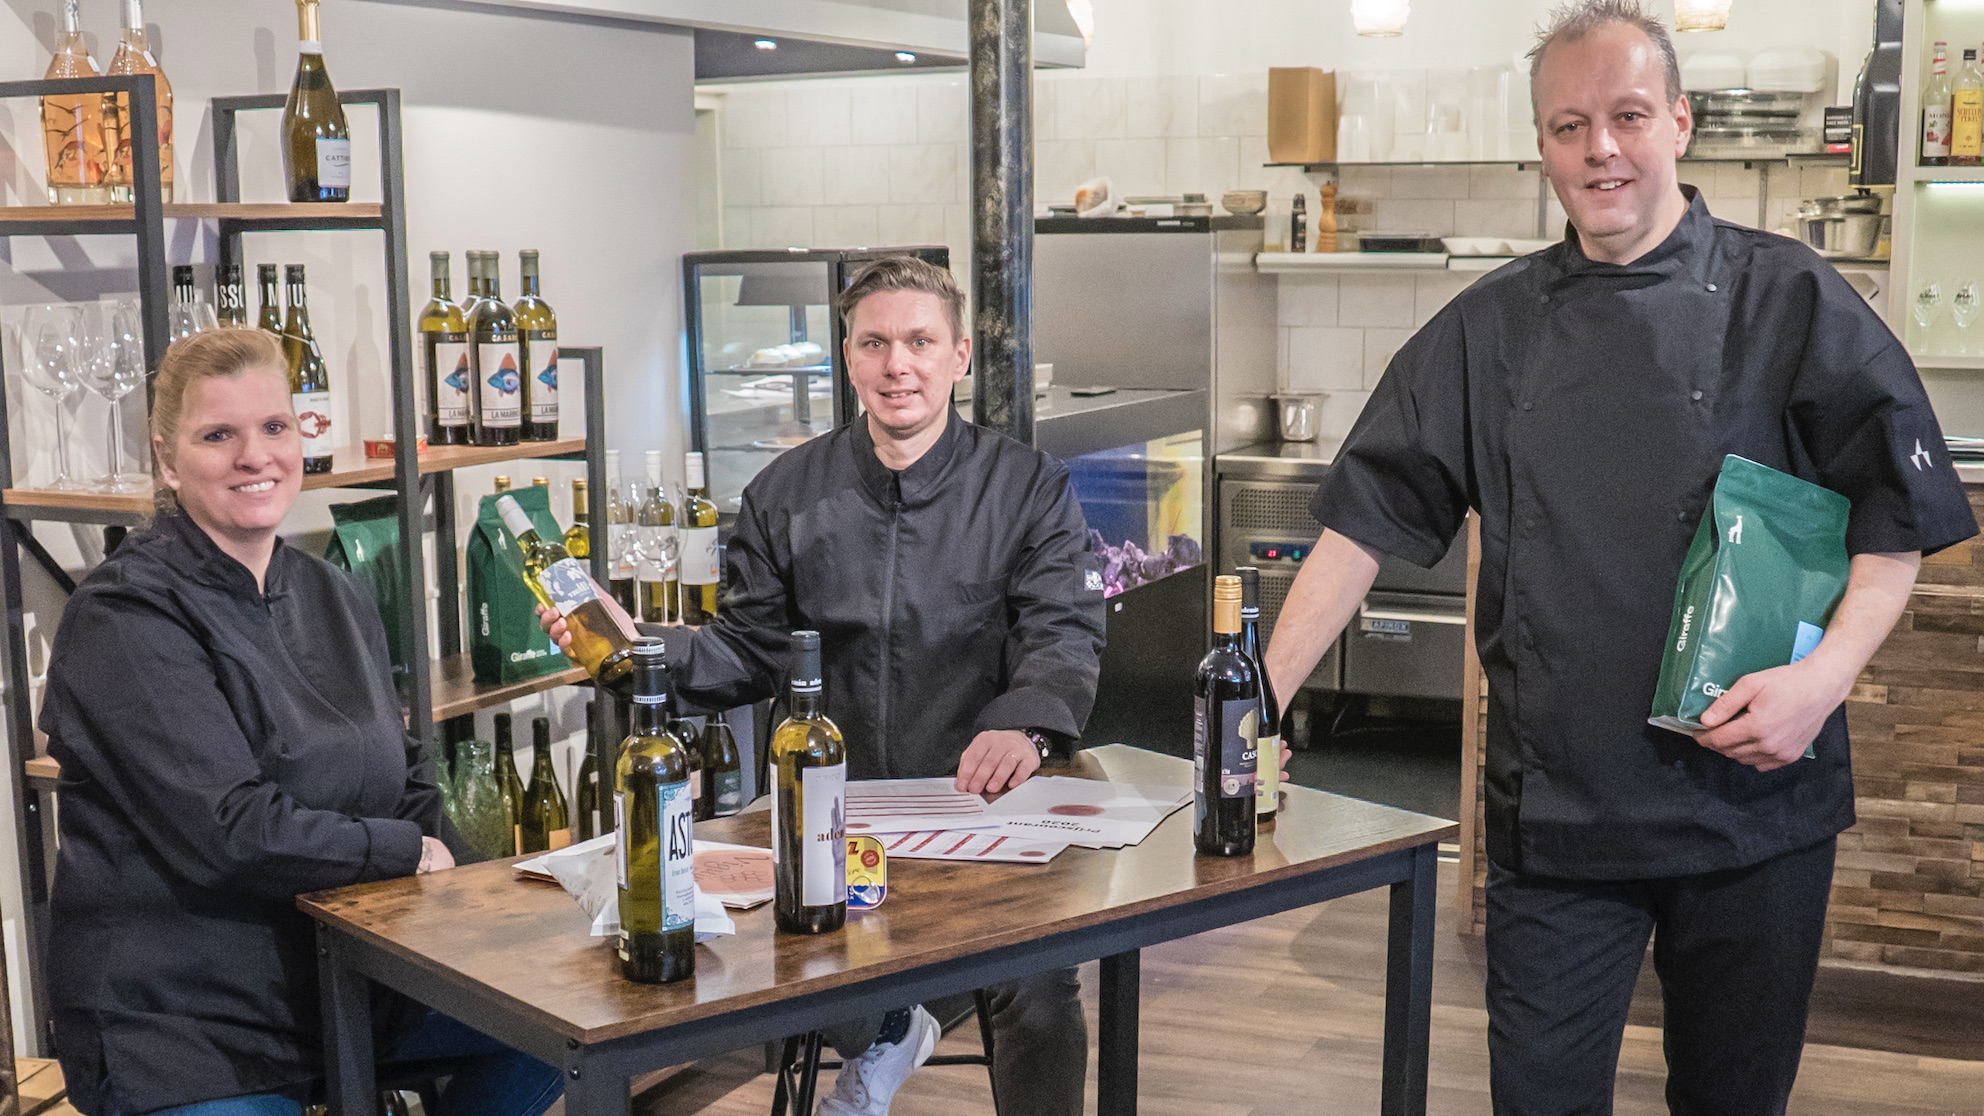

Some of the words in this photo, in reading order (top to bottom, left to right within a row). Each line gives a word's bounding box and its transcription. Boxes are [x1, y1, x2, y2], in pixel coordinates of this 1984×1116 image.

[1676, 605, 1695, 653] Giraffe
[1006, 821, 1101, 834] Prijscourant
[847, 841, 859, 855] Z
